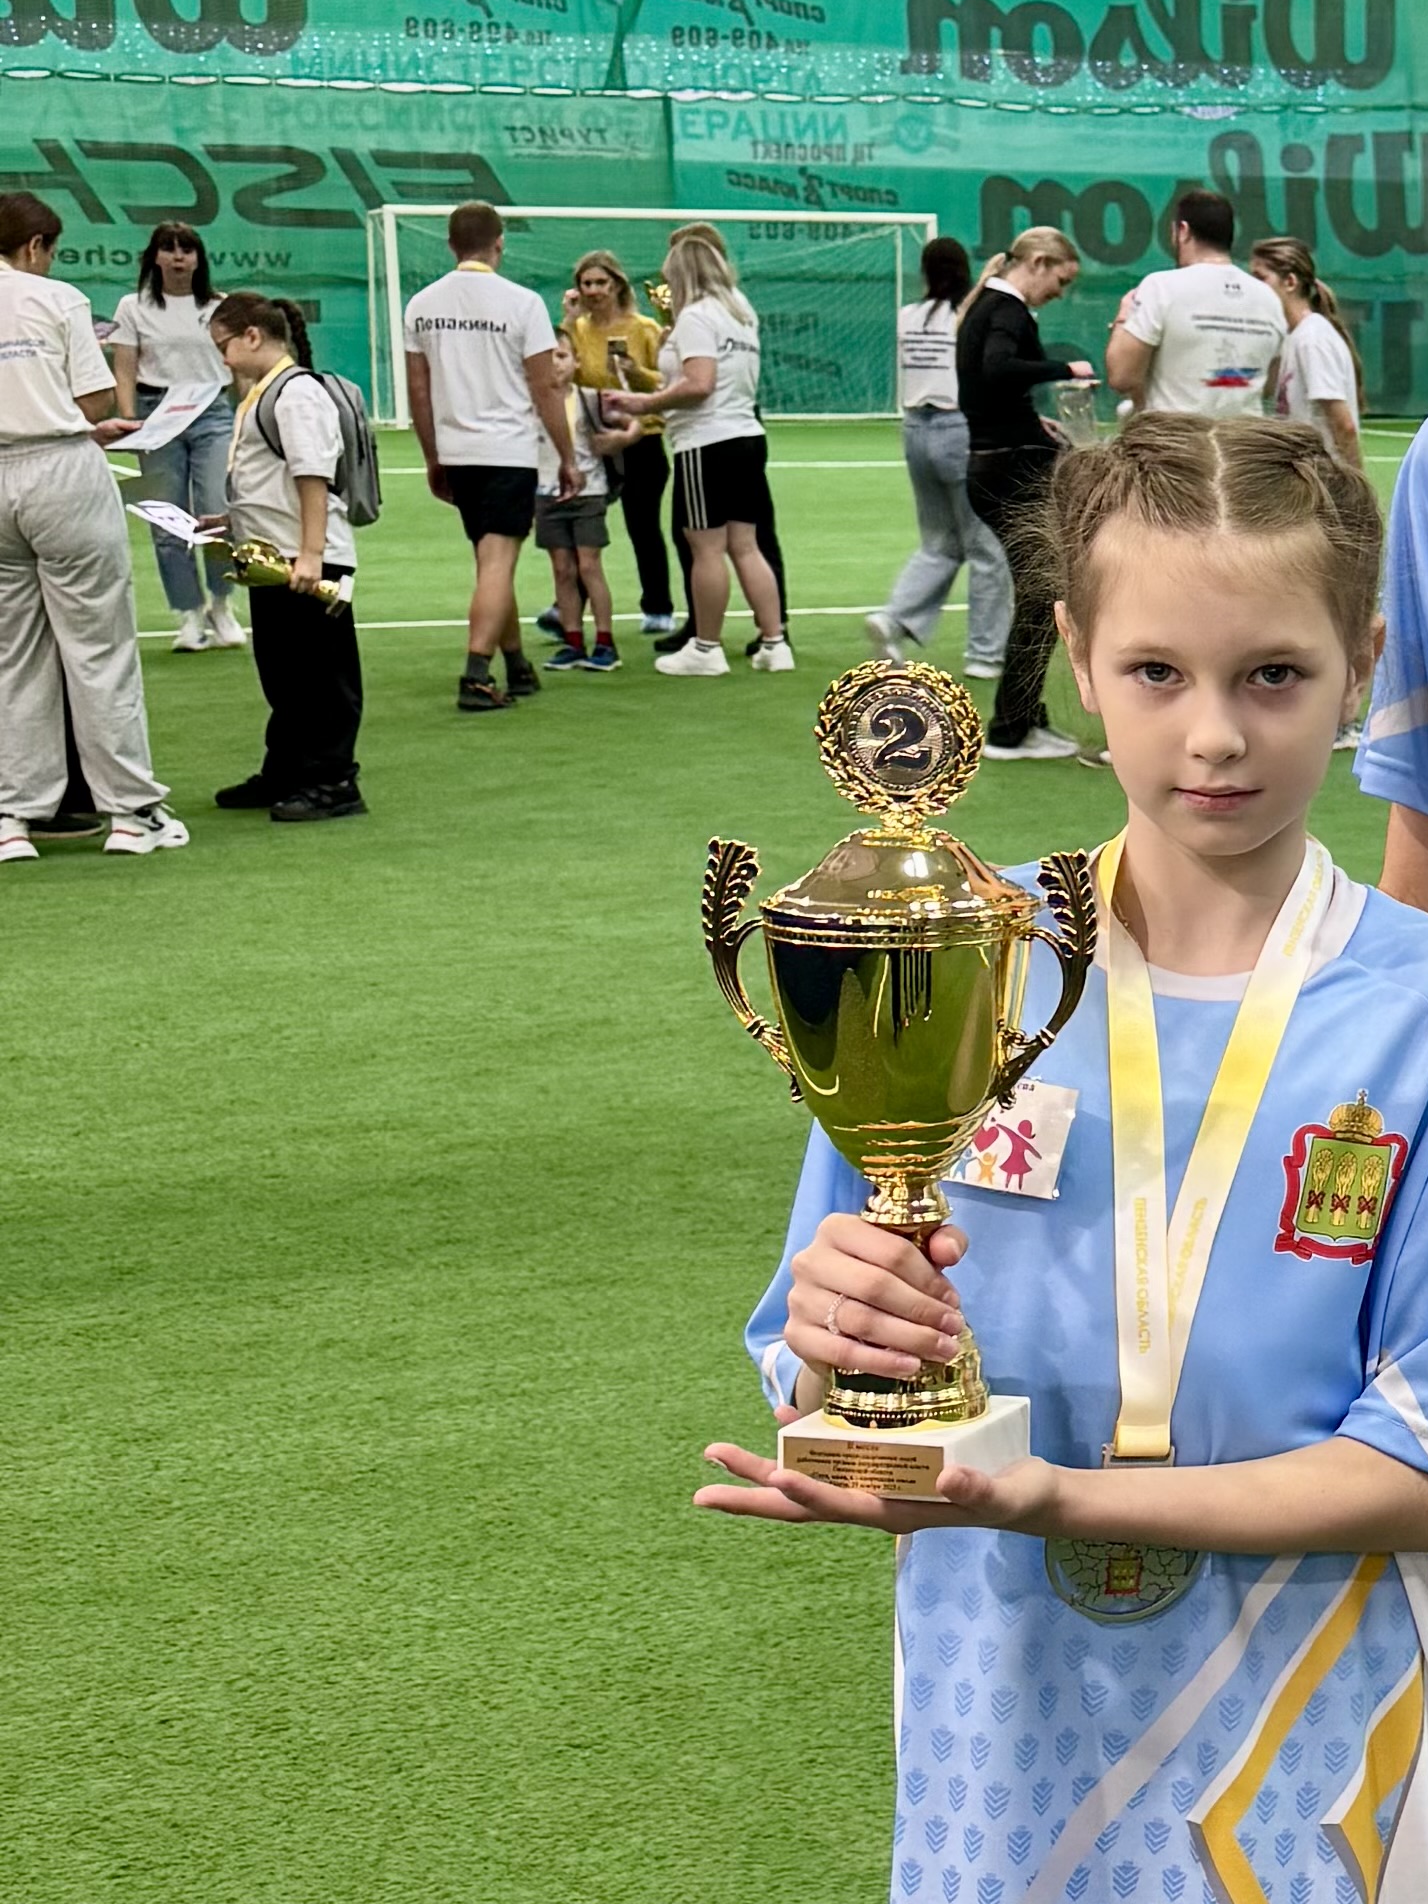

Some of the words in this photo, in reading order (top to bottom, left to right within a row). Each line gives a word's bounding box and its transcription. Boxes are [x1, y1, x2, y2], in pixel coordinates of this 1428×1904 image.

[871, 704, 931, 770] 2
[1133, 1197, 1149, 1285] ПЕНЗЕНСКАЯ
[1136, 1288, 1151, 1355] ОБЛАСТЬ
